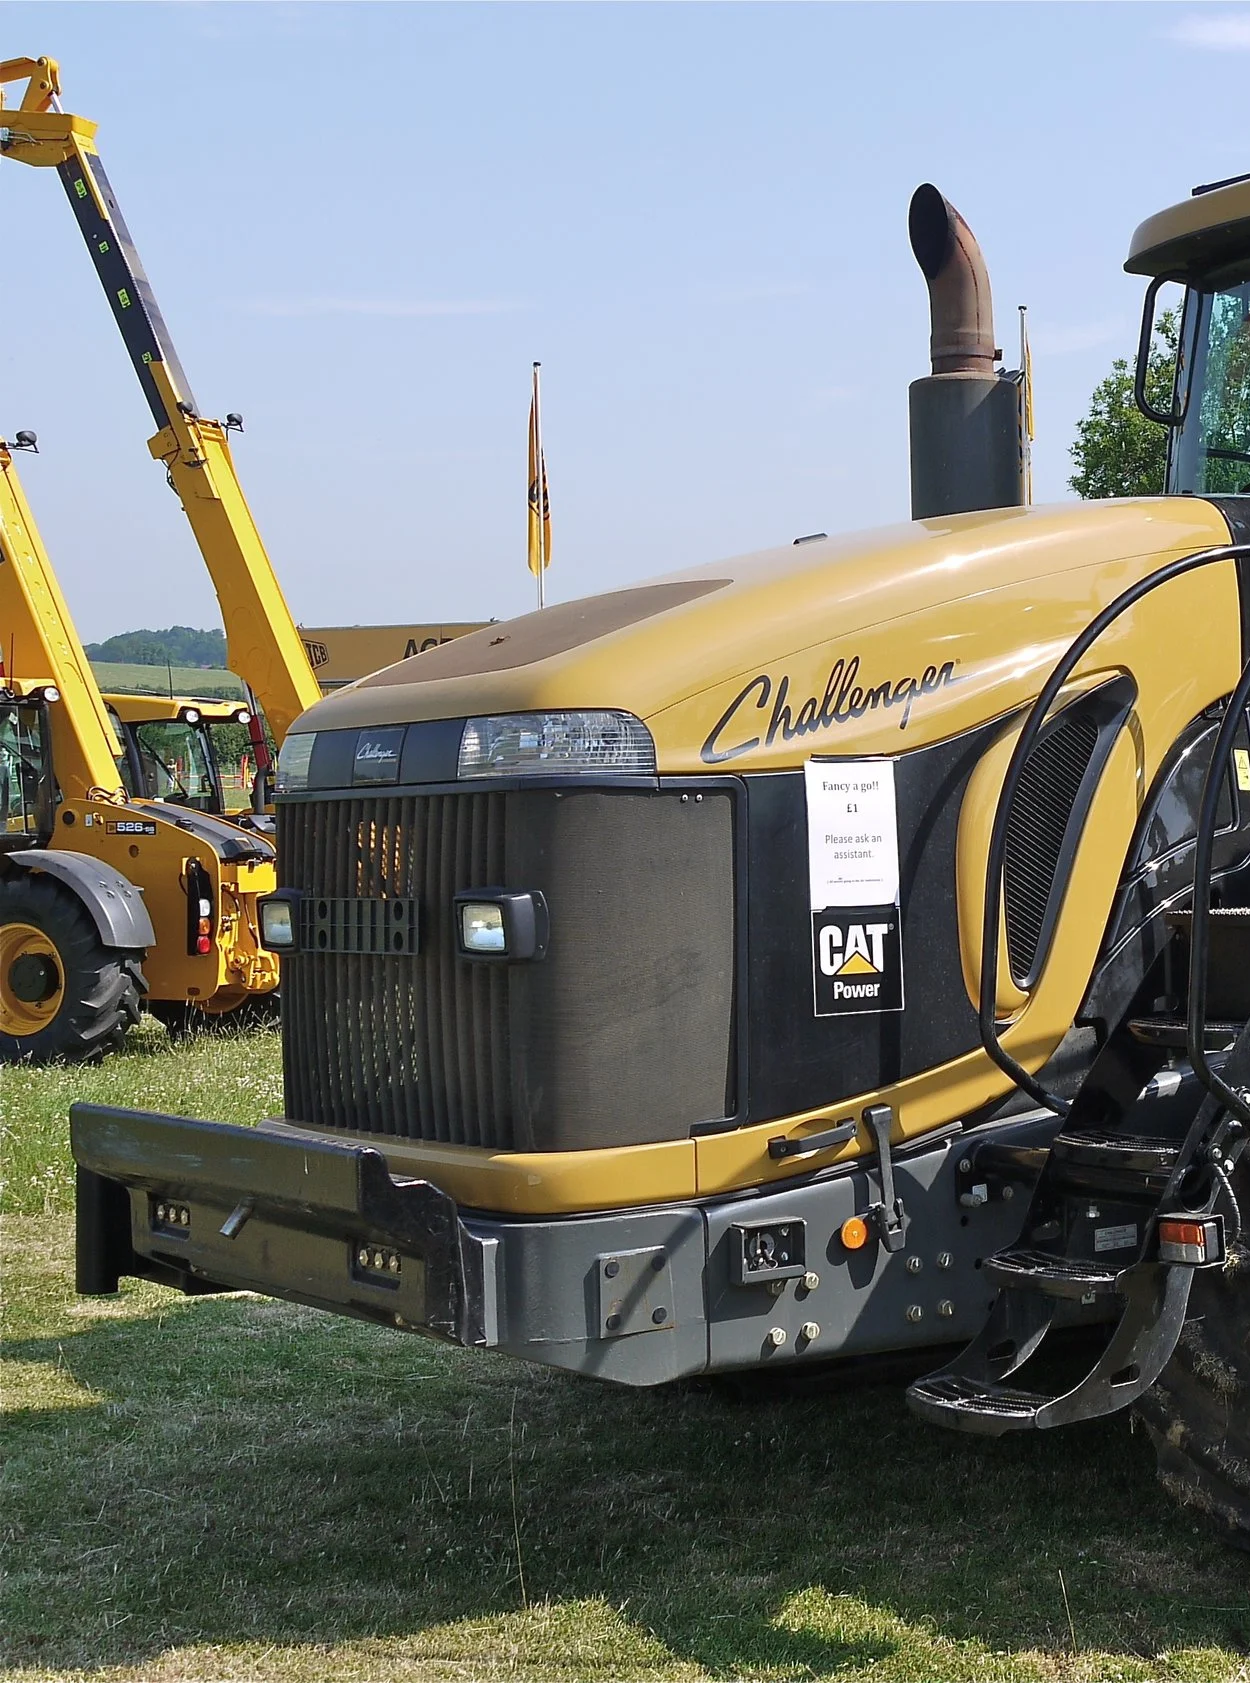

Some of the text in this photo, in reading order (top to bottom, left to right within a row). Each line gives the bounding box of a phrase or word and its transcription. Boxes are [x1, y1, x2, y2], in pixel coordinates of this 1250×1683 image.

[305, 643, 327, 667] JCB
[700, 656, 962, 764] Challenger
[822, 781, 879, 793] Fancy a go!!
[847, 803, 858, 813] £1
[825, 833, 882, 844] Please ask an
[834, 850, 875, 859] assistant.
[819, 923, 888, 976] CAT
[833, 981, 880, 999] Power
